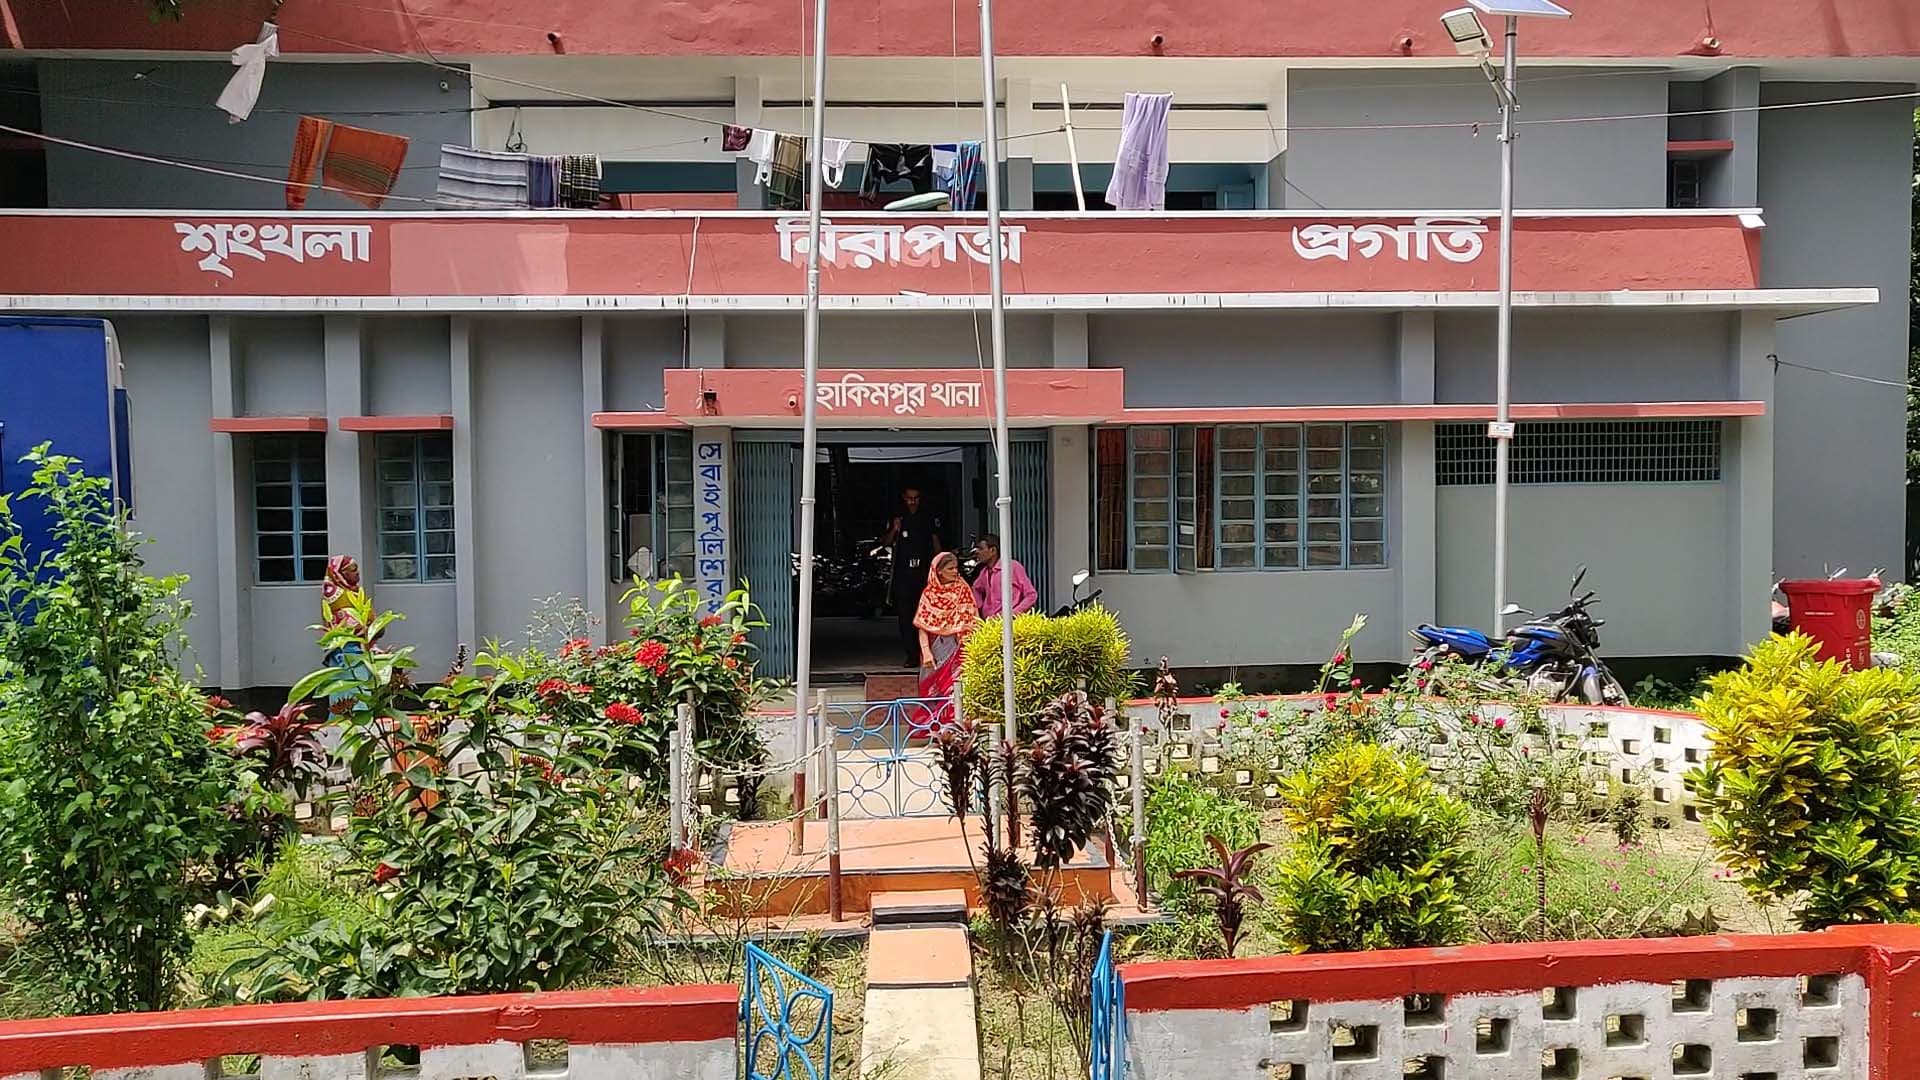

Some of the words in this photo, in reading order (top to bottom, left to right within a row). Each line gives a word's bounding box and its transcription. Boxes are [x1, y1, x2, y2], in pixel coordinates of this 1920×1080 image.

[174, 222, 372, 278] শৃংখলা
[775, 217, 1028, 269] নিরাপত্তা
[1292, 217, 1489, 263] প্রগতি
[816, 373, 927, 415] হাকিমপুর
[930, 381, 982, 408] থানা
